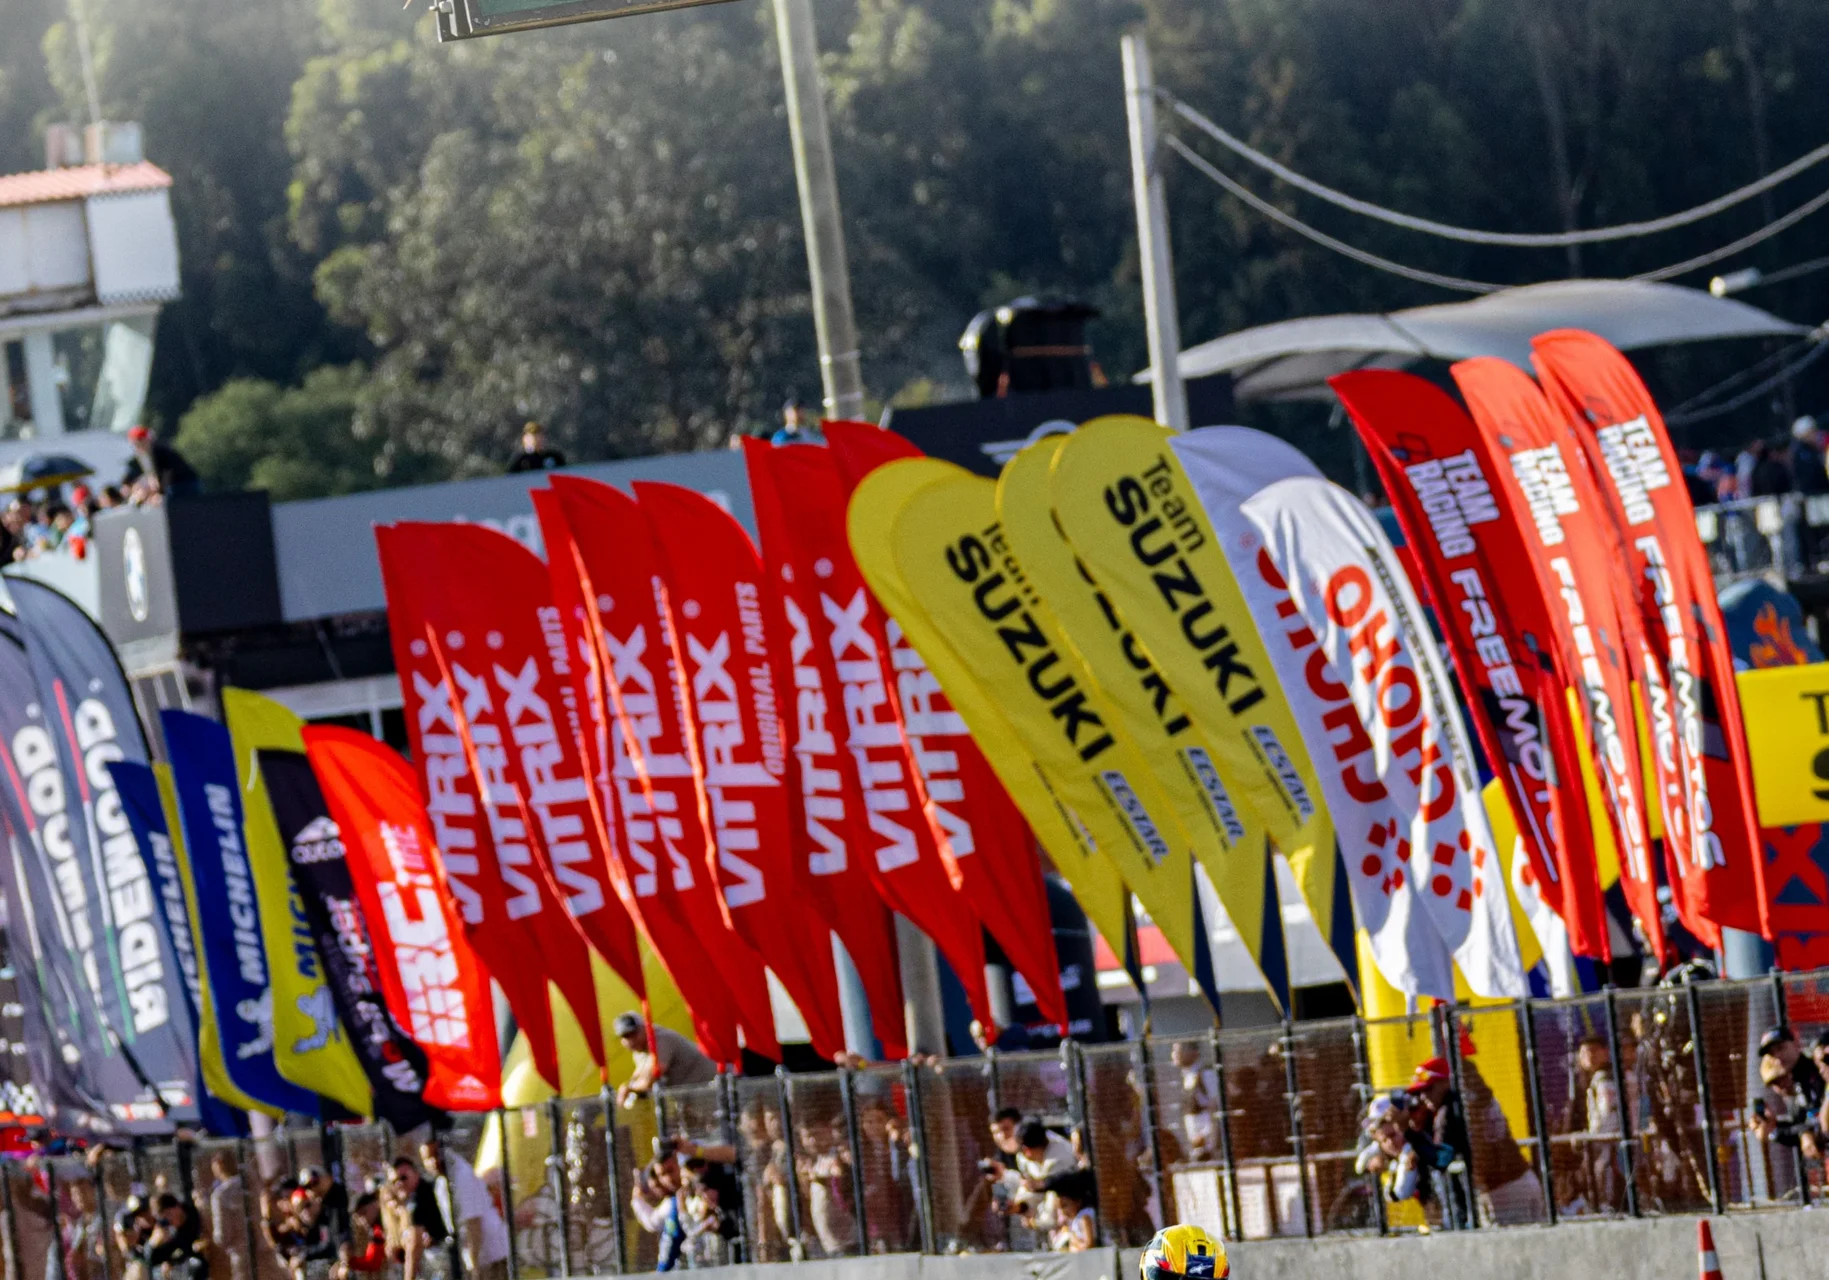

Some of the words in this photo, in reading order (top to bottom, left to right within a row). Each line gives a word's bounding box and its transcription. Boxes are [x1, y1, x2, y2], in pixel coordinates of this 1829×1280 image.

[1142, 452, 1206, 554] Team
[1405, 458, 1476, 559] RACING
[1441, 448, 1501, 526] TEAM
[1509, 450, 1564, 547] RACING
[1532, 441, 1580, 516] TEAM
[1597, 424, 1655, 526] RACING
[1621, 412, 1671, 491] TEAM
[735, 580, 768, 656] PARTS
[946, 532, 1116, 762] SUZUKI
[1104, 474, 1266, 717] SUZUKI
[1323, 563, 1456, 823] CHOHO
[1635, 534, 1727, 872] FREEMOTOS
[411, 669, 485, 925] VITRIX
[451, 659, 543, 921] VITRIX
[491, 654, 606, 918] VITRIX
[686, 629, 783, 908] VITRIX
[748, 661, 788, 776] ORIGINAL
[784, 595, 848, 877] VITRIX
[819, 586, 921, 874] VITRIX
[1549, 556, 1648, 884] FREEMOTOS
[204, 782, 267, 986] MICHELIN
